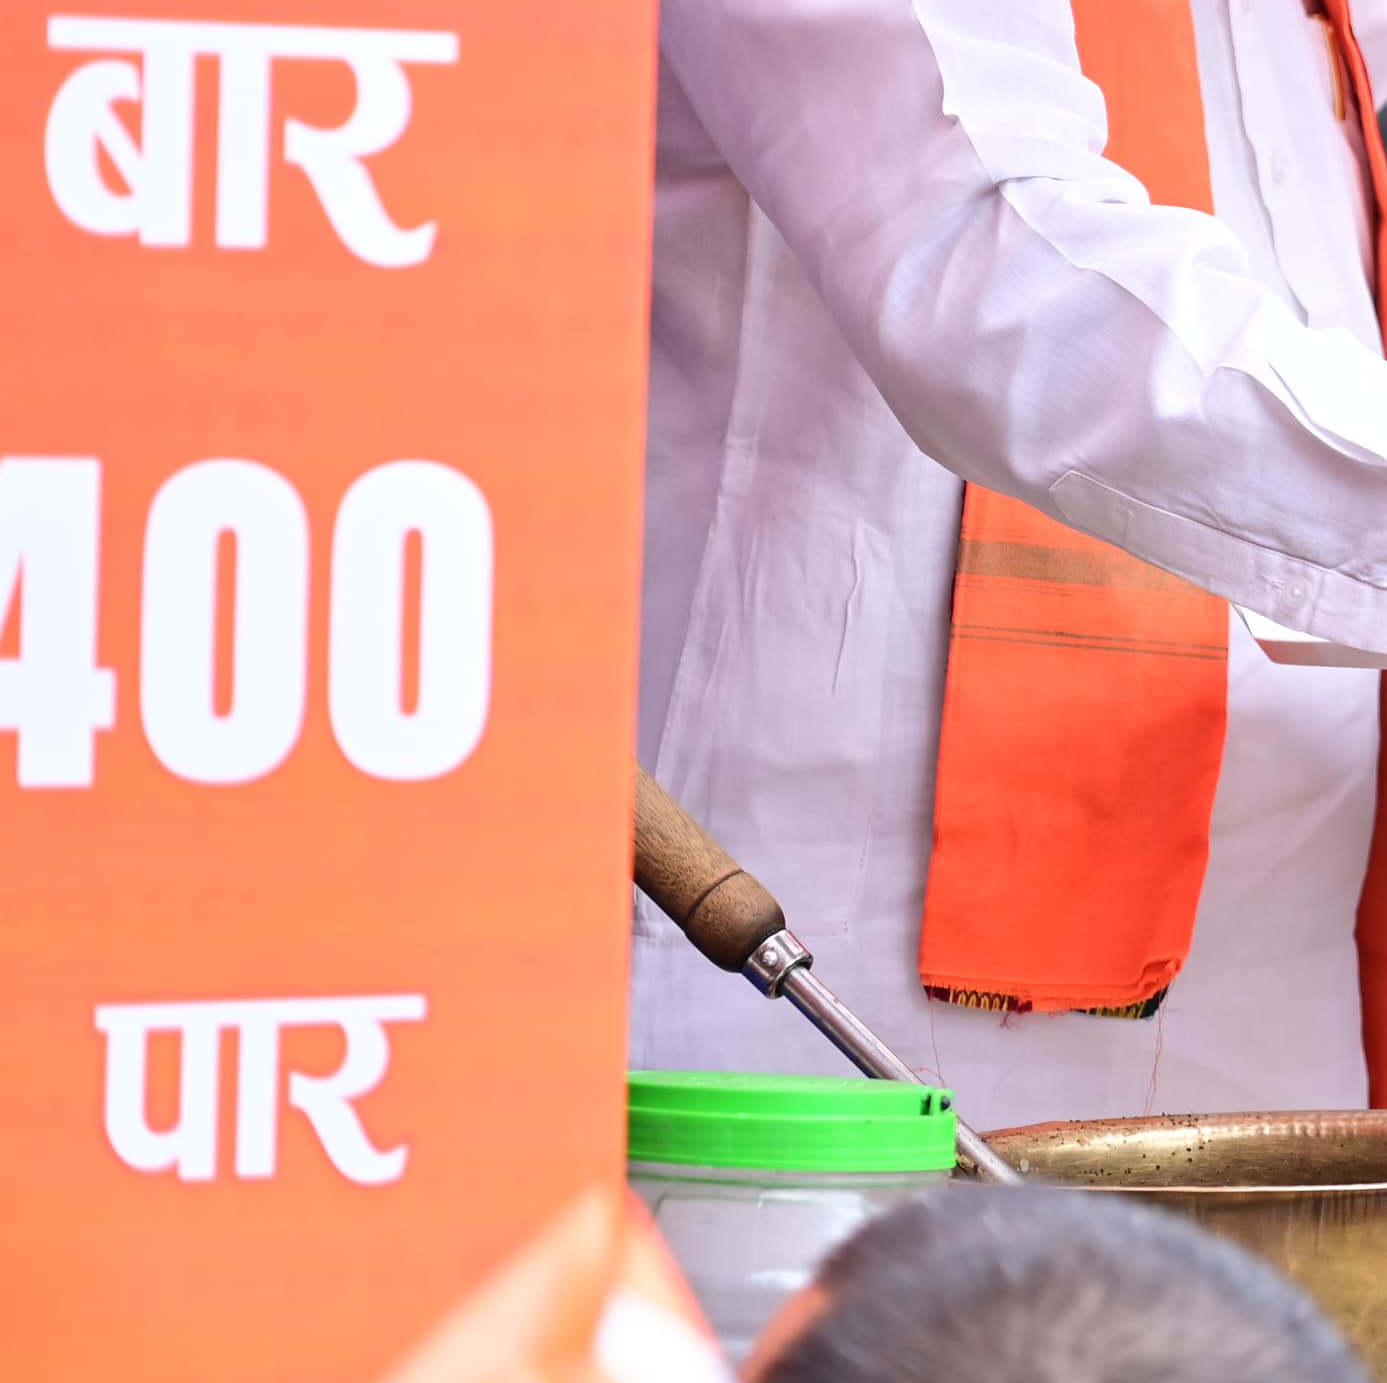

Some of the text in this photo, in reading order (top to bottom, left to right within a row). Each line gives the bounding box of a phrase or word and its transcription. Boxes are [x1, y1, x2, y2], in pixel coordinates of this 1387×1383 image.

[43, 14, 461, 270] बार
[0, 455, 496, 789] 400
[94, 992, 428, 1185] पार
